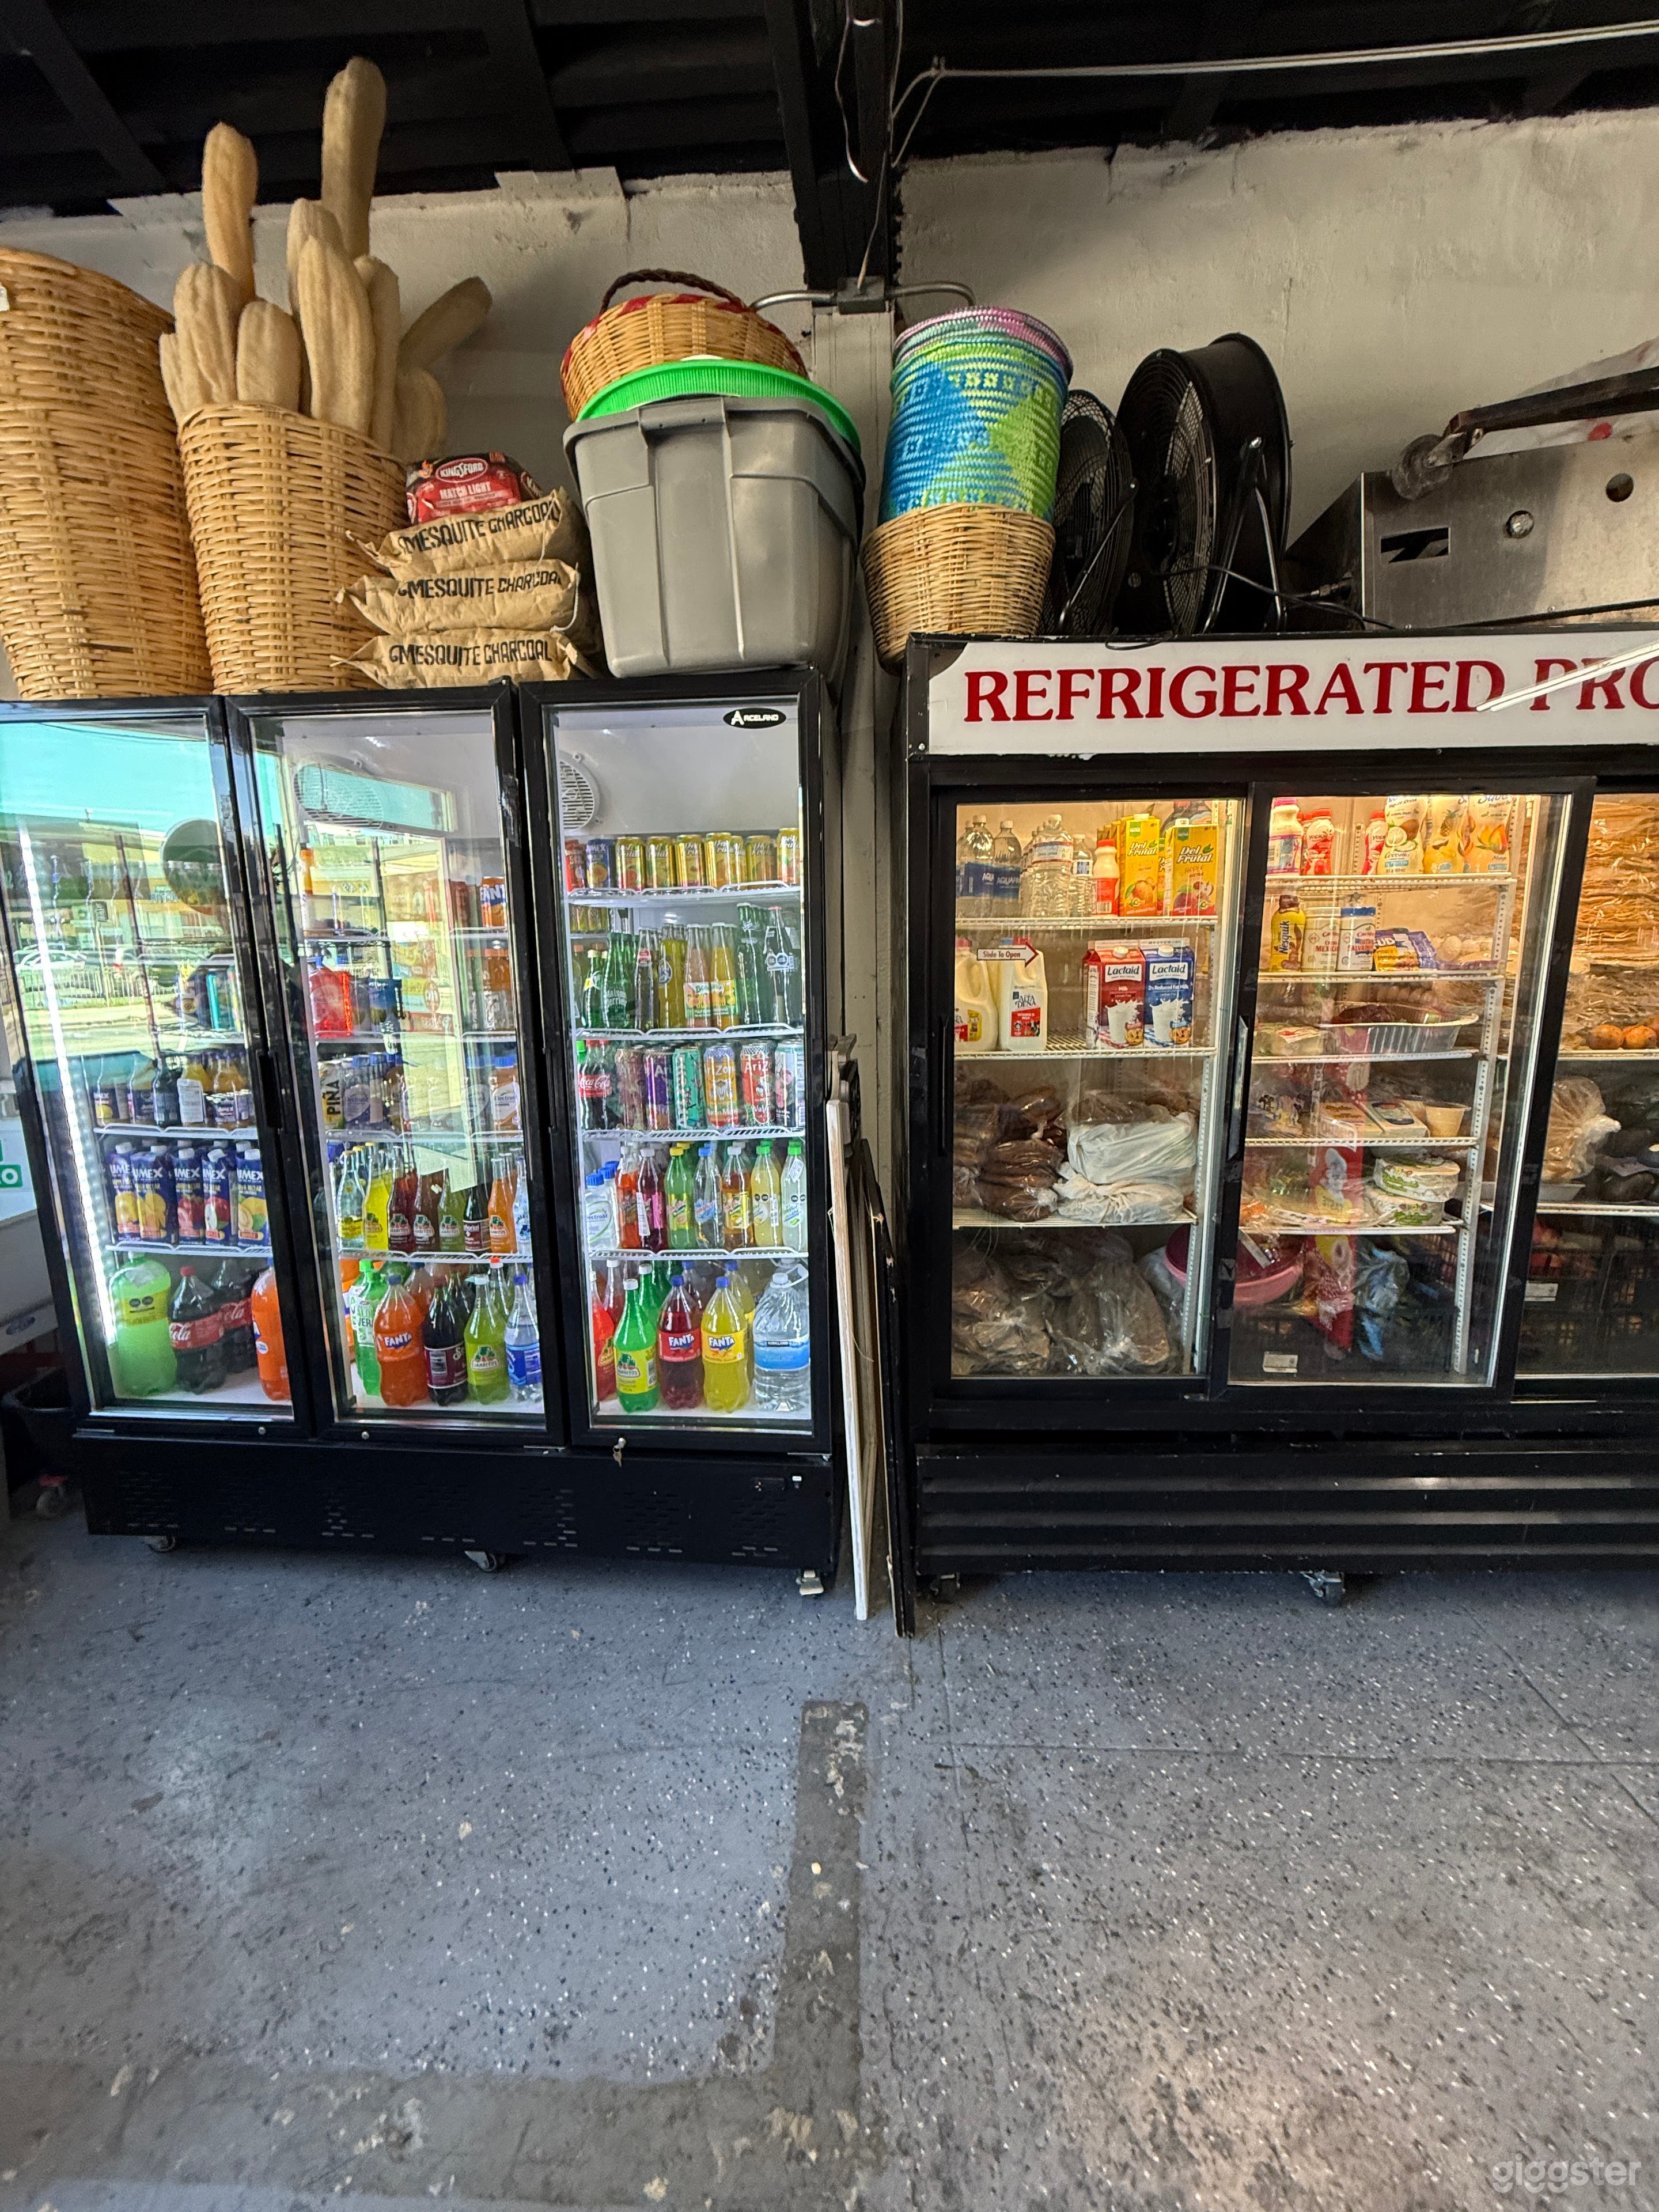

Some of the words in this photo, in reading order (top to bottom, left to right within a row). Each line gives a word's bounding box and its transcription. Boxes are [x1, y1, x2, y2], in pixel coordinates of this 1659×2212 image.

[440, 463, 484, 478] KINGSFORD
[440, 486, 467, 499] MATCH
[467, 481, 491, 494] LIGHT
[397, 520, 486, 554] MESQUITE
[398, 577, 495, 599] MESQUITE
[389, 644, 480, 665] MESQUITE
[483, 639, 552, 662] CHARCOAL
[964, 660, 1505, 722] REFRIGERATED
[1127, 847, 1157, 857] Frutal
[1131, 840, 1147, 850] Del
[1180, 845, 1202, 855] Del
[1176, 853, 1214, 863] Frutal
[1278, 921, 1290, 955] Nesquik
[1005, 951, 1021, 959] Open
[1107, 965, 1139, 976] Lactaid
[1152, 964, 1185, 974] Lactaid
[1019, 995, 1035, 1003] ALTA
[322, 1081, 340, 1115] PIÑA
[0, 1168, 18, 1185] O
[384, 1332, 412, 1347] FANTA
[669, 1334, 695, 1347] FANTA
[709, 1336, 735, 1347] FANTA
